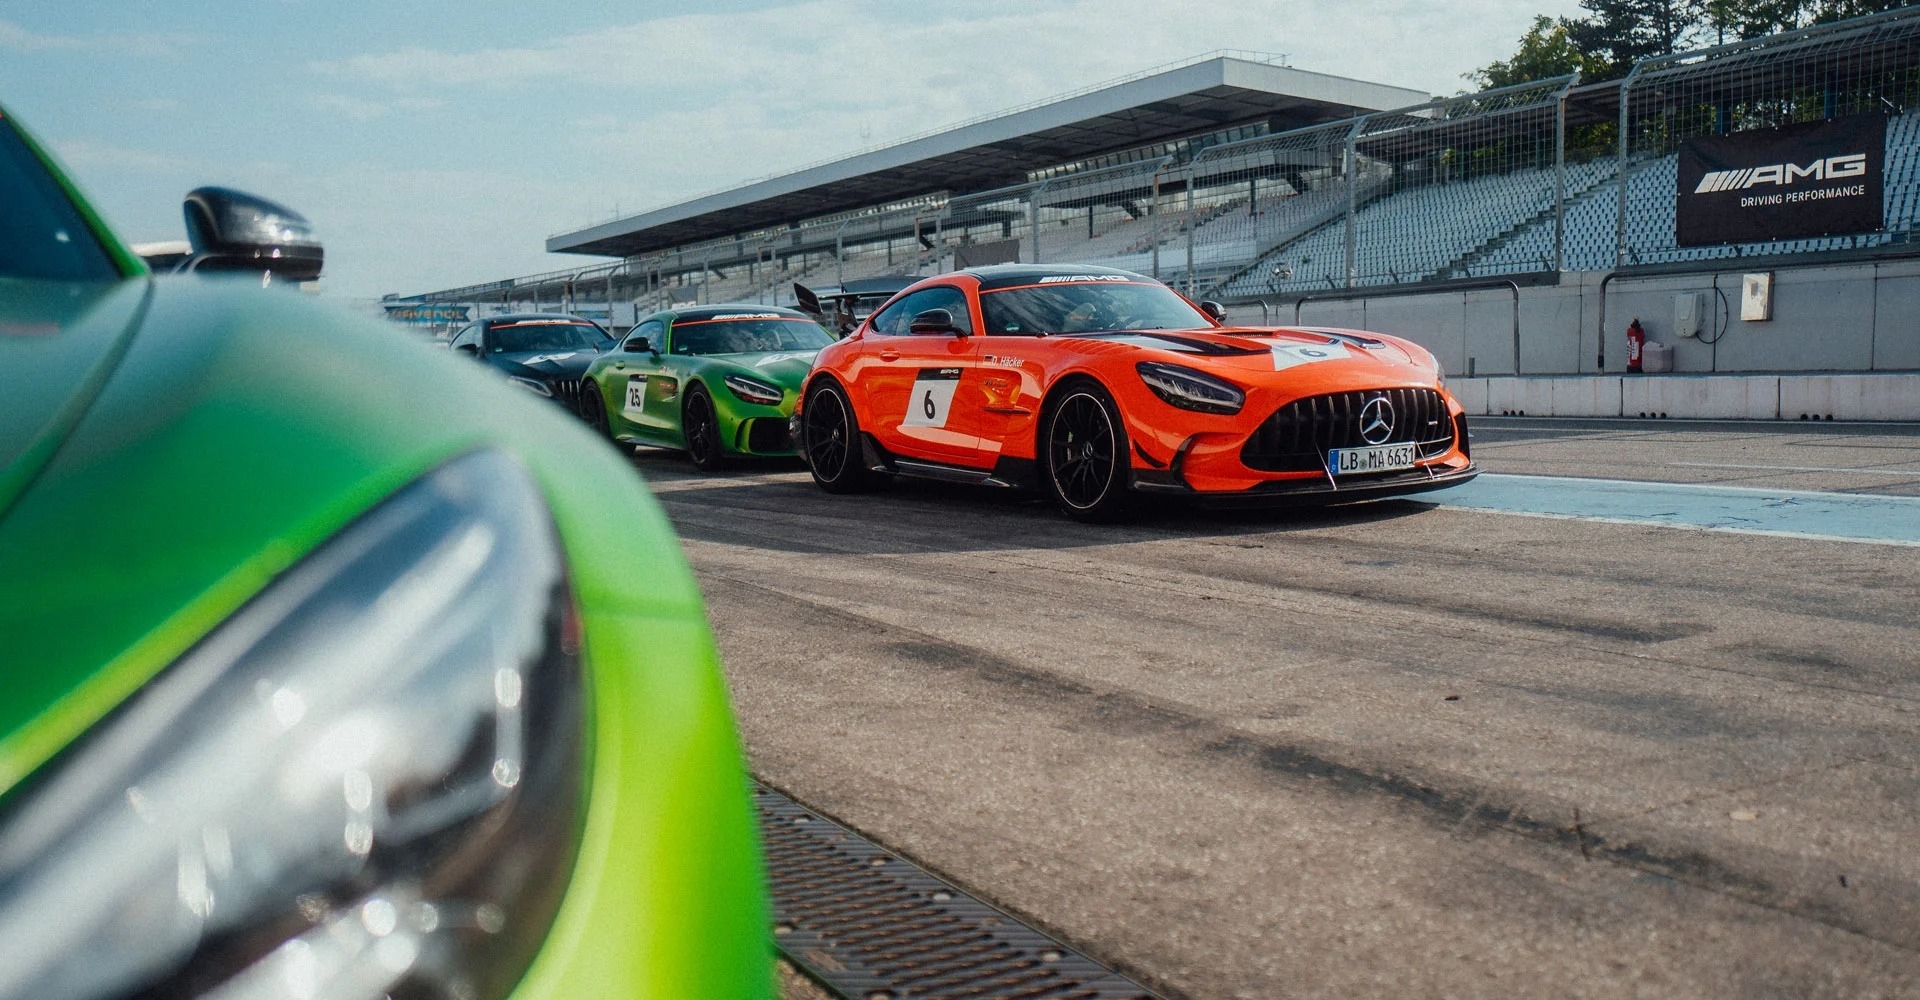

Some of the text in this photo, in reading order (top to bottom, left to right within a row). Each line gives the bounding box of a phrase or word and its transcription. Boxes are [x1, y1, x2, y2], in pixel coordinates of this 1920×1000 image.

[1742, 153, 1866, 189] AMG
[1741, 184, 1865, 208] DRIVING PERFORMANCE
[1299, 348, 1327, 357] 6
[629, 387, 641, 407] 25
[924, 390, 935, 419] 6
[1341, 447, 1415, 471] LB MA 6631
